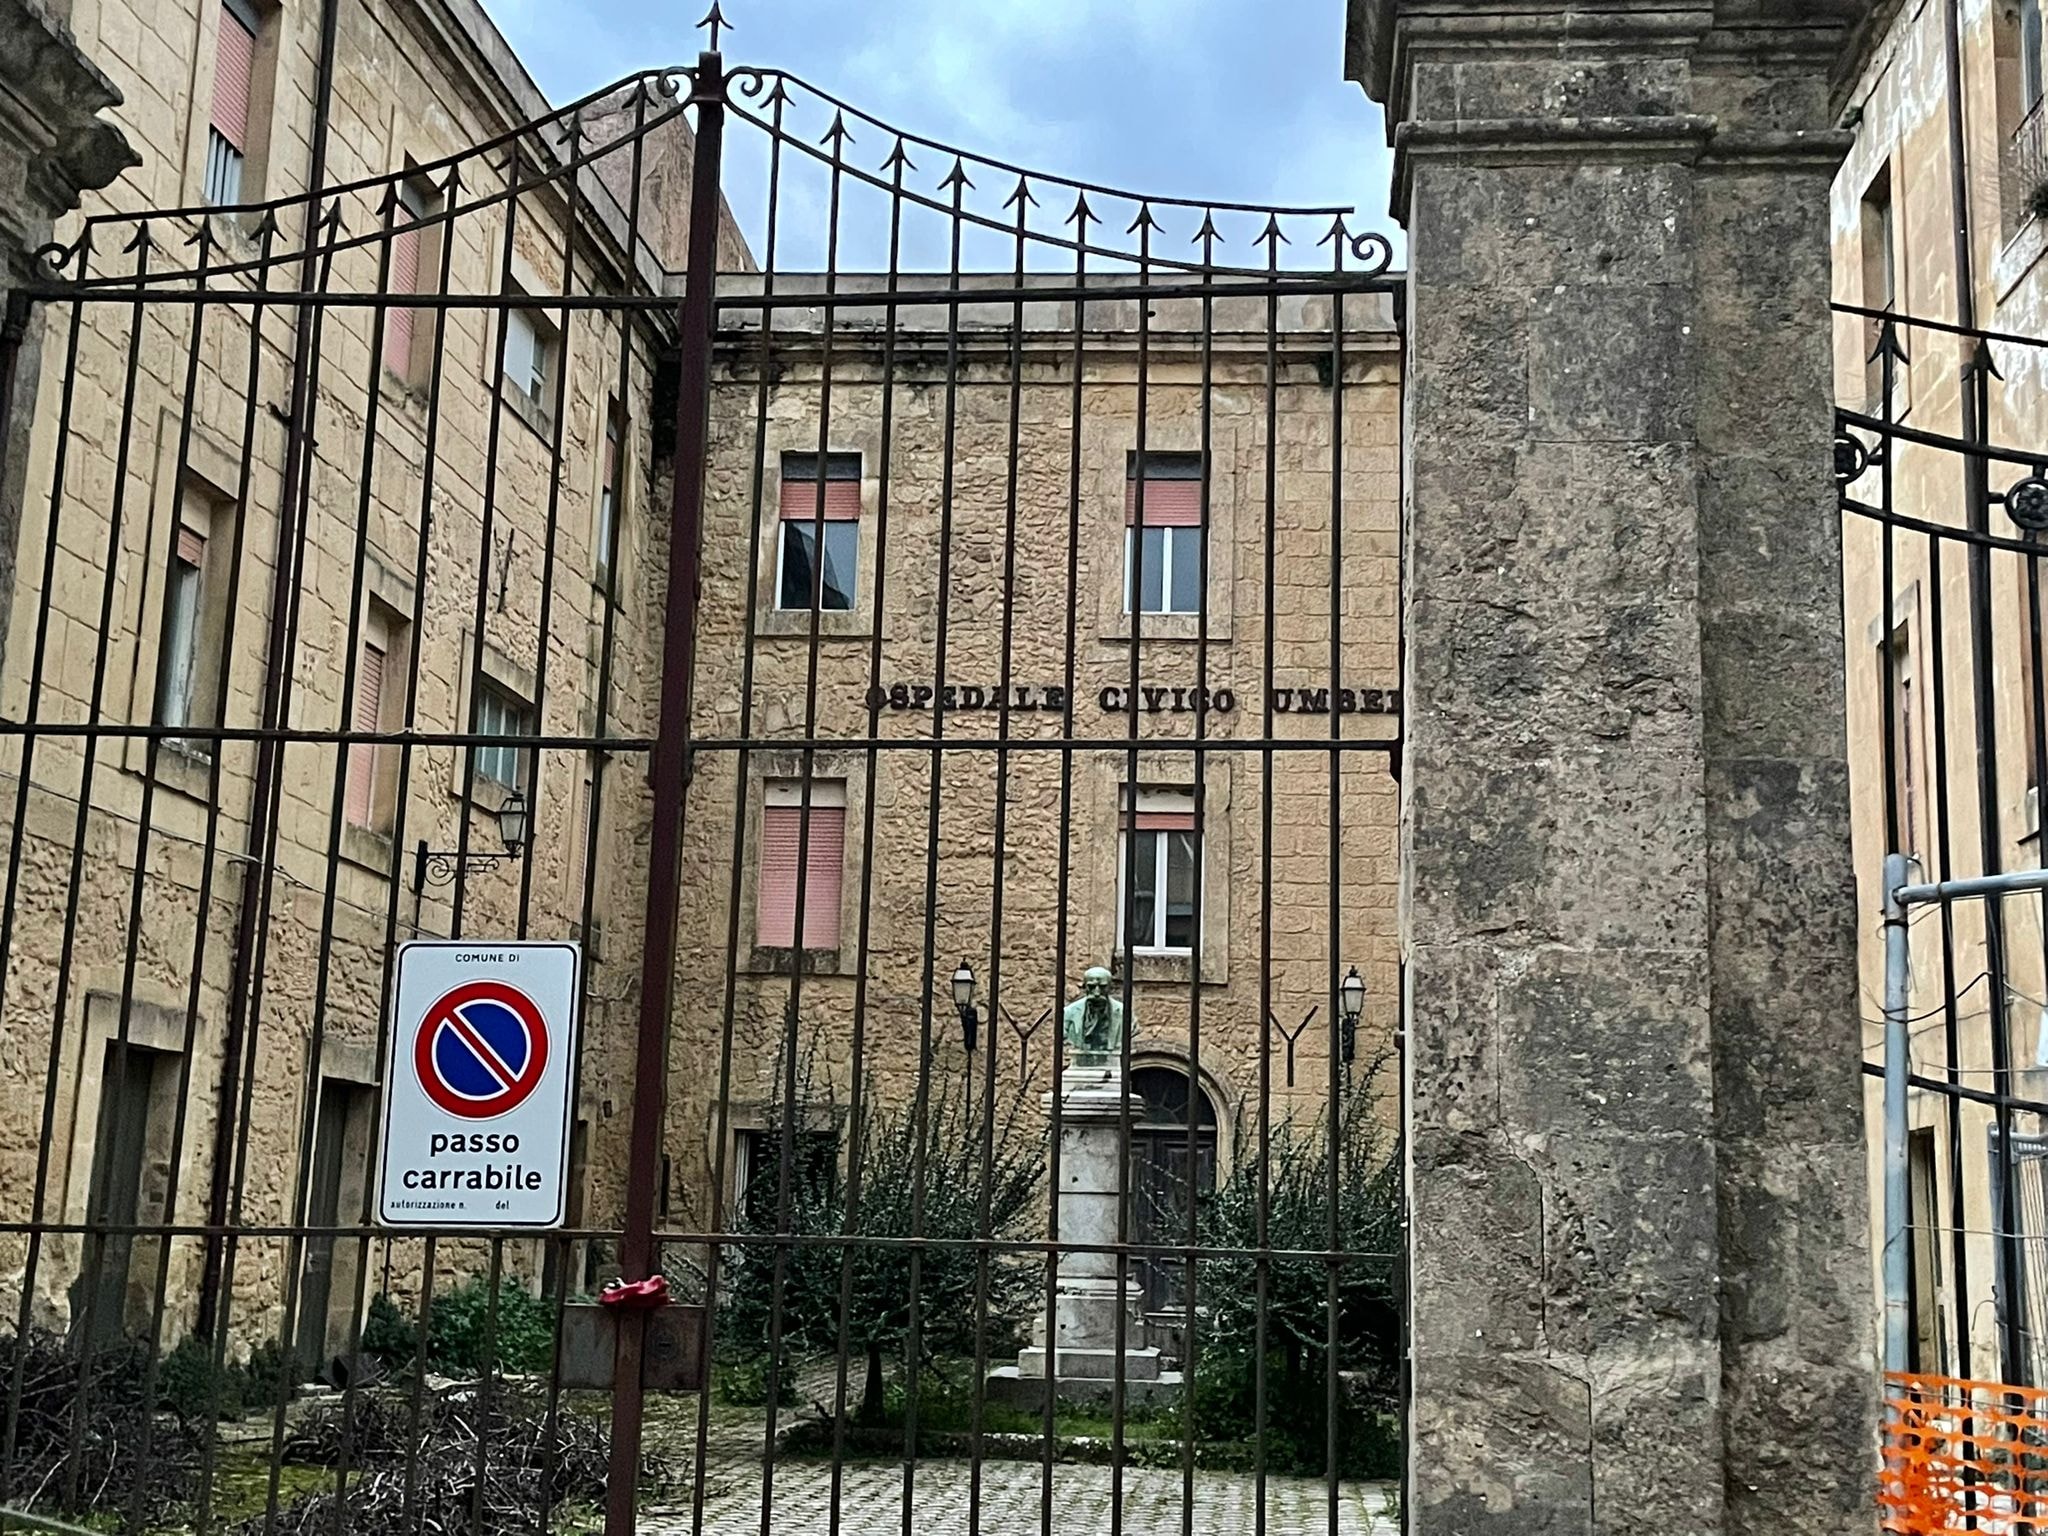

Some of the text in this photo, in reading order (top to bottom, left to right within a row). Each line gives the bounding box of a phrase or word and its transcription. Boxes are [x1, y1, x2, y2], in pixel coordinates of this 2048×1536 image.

[1099, 686, 1235, 712] CIVICO
[455, 953, 504, 963] COMUNE
[430, 1133, 520, 1157] passo
[402, 1164, 542, 1191] carrabile
[390, 1200, 456, 1209] autorizzazione
[495, 1200, 510, 1210] del
